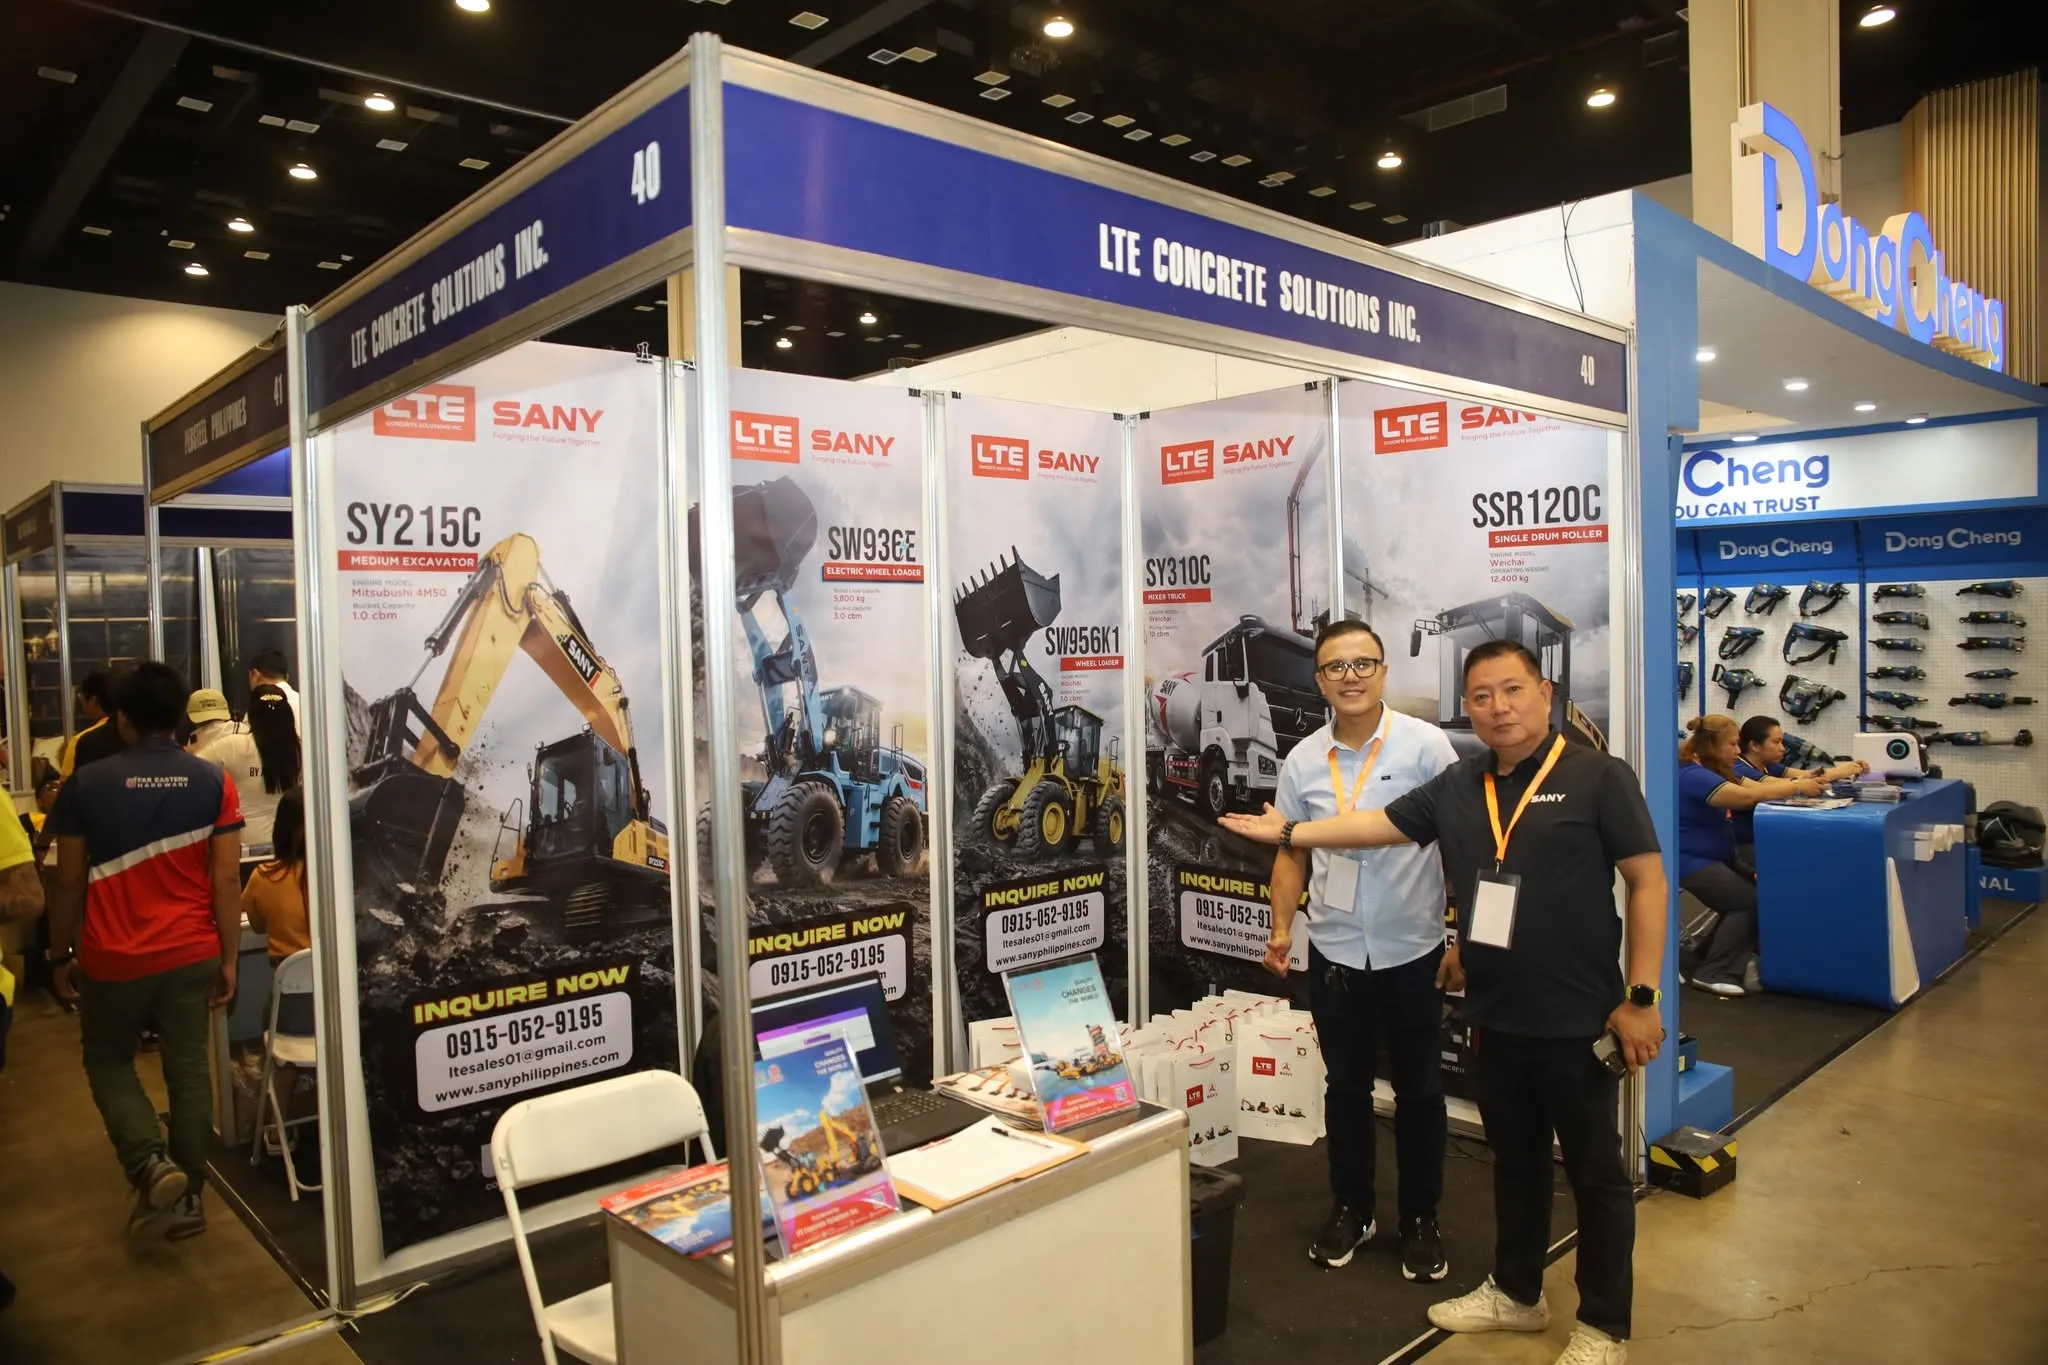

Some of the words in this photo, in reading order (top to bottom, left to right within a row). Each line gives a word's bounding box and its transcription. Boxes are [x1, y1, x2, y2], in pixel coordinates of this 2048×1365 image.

[630, 140, 661, 206] 40
[1738, 100, 2004, 373] DongCheng
[351, 325, 368, 369] LTE
[371, 293, 427, 359] CONCRETE
[431, 243, 507, 326] SOLUTIONS
[514, 219, 550, 281] INC.
[1099, 223, 1142, 277] LTE
[1153, 237, 1267, 308] CONCRETE
[1279, 271, 1381, 335] SOLUTIONS
[1388, 301, 1422, 344] INC.
[1580, 354, 1595, 387] 40
[273, 373, 283, 408] 41
[211, 395, 247, 441] PHILIPPINES
[493, 400, 605, 433] SANY
[1381, 411, 1440, 438] LTE
[1460, 406, 1537, 430] SAN
[493, 431, 525, 443] Forging
[527, 432, 540, 442] the
[735, 419, 793, 448] LTE
[811, 429, 896, 457] SANY
[1461, 432, 1488, 442] Forging
[1489, 431, 1501, 439] the
[1502, 428, 1527, 438] Future
[1528, 424, 1561, 435] Together
[977, 442, 1024, 466] LTE
[1038, 449, 1100, 474] SANY
[1166, 448, 1208, 471] LTE
[1223, 435, 1295, 465] SANY
[1683, 450, 1829, 497] Cheng
[1472, 484, 1601, 529] SSR120C
[1675, 505, 1699, 518] OU
[1705, 501, 1746, 517] CAN
[1753, 496, 1820, 514] TRUST
[346, 501, 481, 548] SY215C
[1494, 534, 1529, 544] SINGLE
[1531, 532, 1559, 542] DRUM
[1562, 529, 1603, 539] ROLLER
[828, 526, 916, 562] SW936E
[1719, 537, 1833, 560] DongCheng
[1885, 528, 2022, 553] DongCheng
[351, 556, 400, 567] MEDIUM
[403, 556, 475, 568] EXCAVATOR
[826, 567, 864, 576] ELECTRIC
[865, 567, 891, 576] WHEEL
[893, 568, 921, 577] LOADER
[1146, 555, 1211, 587] SY310C
[1490, 558, 1525, 567] Weichai
[352, 588, 413, 598] Mitsubushi
[416, 588, 447, 598] 4M50
[1519, 575, 1529, 584] kg
[856, 594, 865, 603] kg
[1148, 593, 1166, 601] MIXER
[352, 611, 368, 620] 1.0
[372, 611, 397, 620] cbm
[847, 612, 862, 620] cbm
[1045, 626, 1119, 656] SW956K1
[1157, 630, 1170, 638] cbm
[568, 639, 594, 678] SANY
[796, 624, 811, 675] SANY
[250, 767, 259, 777] BY
[1530, 793, 1566, 804] SANY
[985, 881, 1060, 907] INQUIRE
[1063, 872, 1105, 892] NOW
[1180, 871, 1255, 897] INQUIRE
[1002, 899, 1089, 934] 0915-052-9195
[1196, 898, 1272, 929] 0915-052-91
[748, 923, 847, 955] INQUIRE
[852, 912, 905, 937] NOW
[1003, 923, 1091, 949] ltesales01@gmail.com
[1197, 920, 1269, 943] ltesales01@gmail
[995, 936, 1098, 967] www.sanyphilippines.com
[1190, 935, 1300, 965] www.sanyphilippim
[771, 943, 885, 986] 0915-052-9195
[414, 981, 548, 1025] INQUIRE
[556, 965, 630, 996] NOW
[1061, 985, 1097, 999] CHANGES
[446, 1002, 604, 1059] 0915-052-9195
[449, 1034, 607, 1079] ltesales01@gmail.com
[435, 1051, 620, 1103] www.sanyphilippines.com
[1188, 1091, 1201, 1101] LTE
